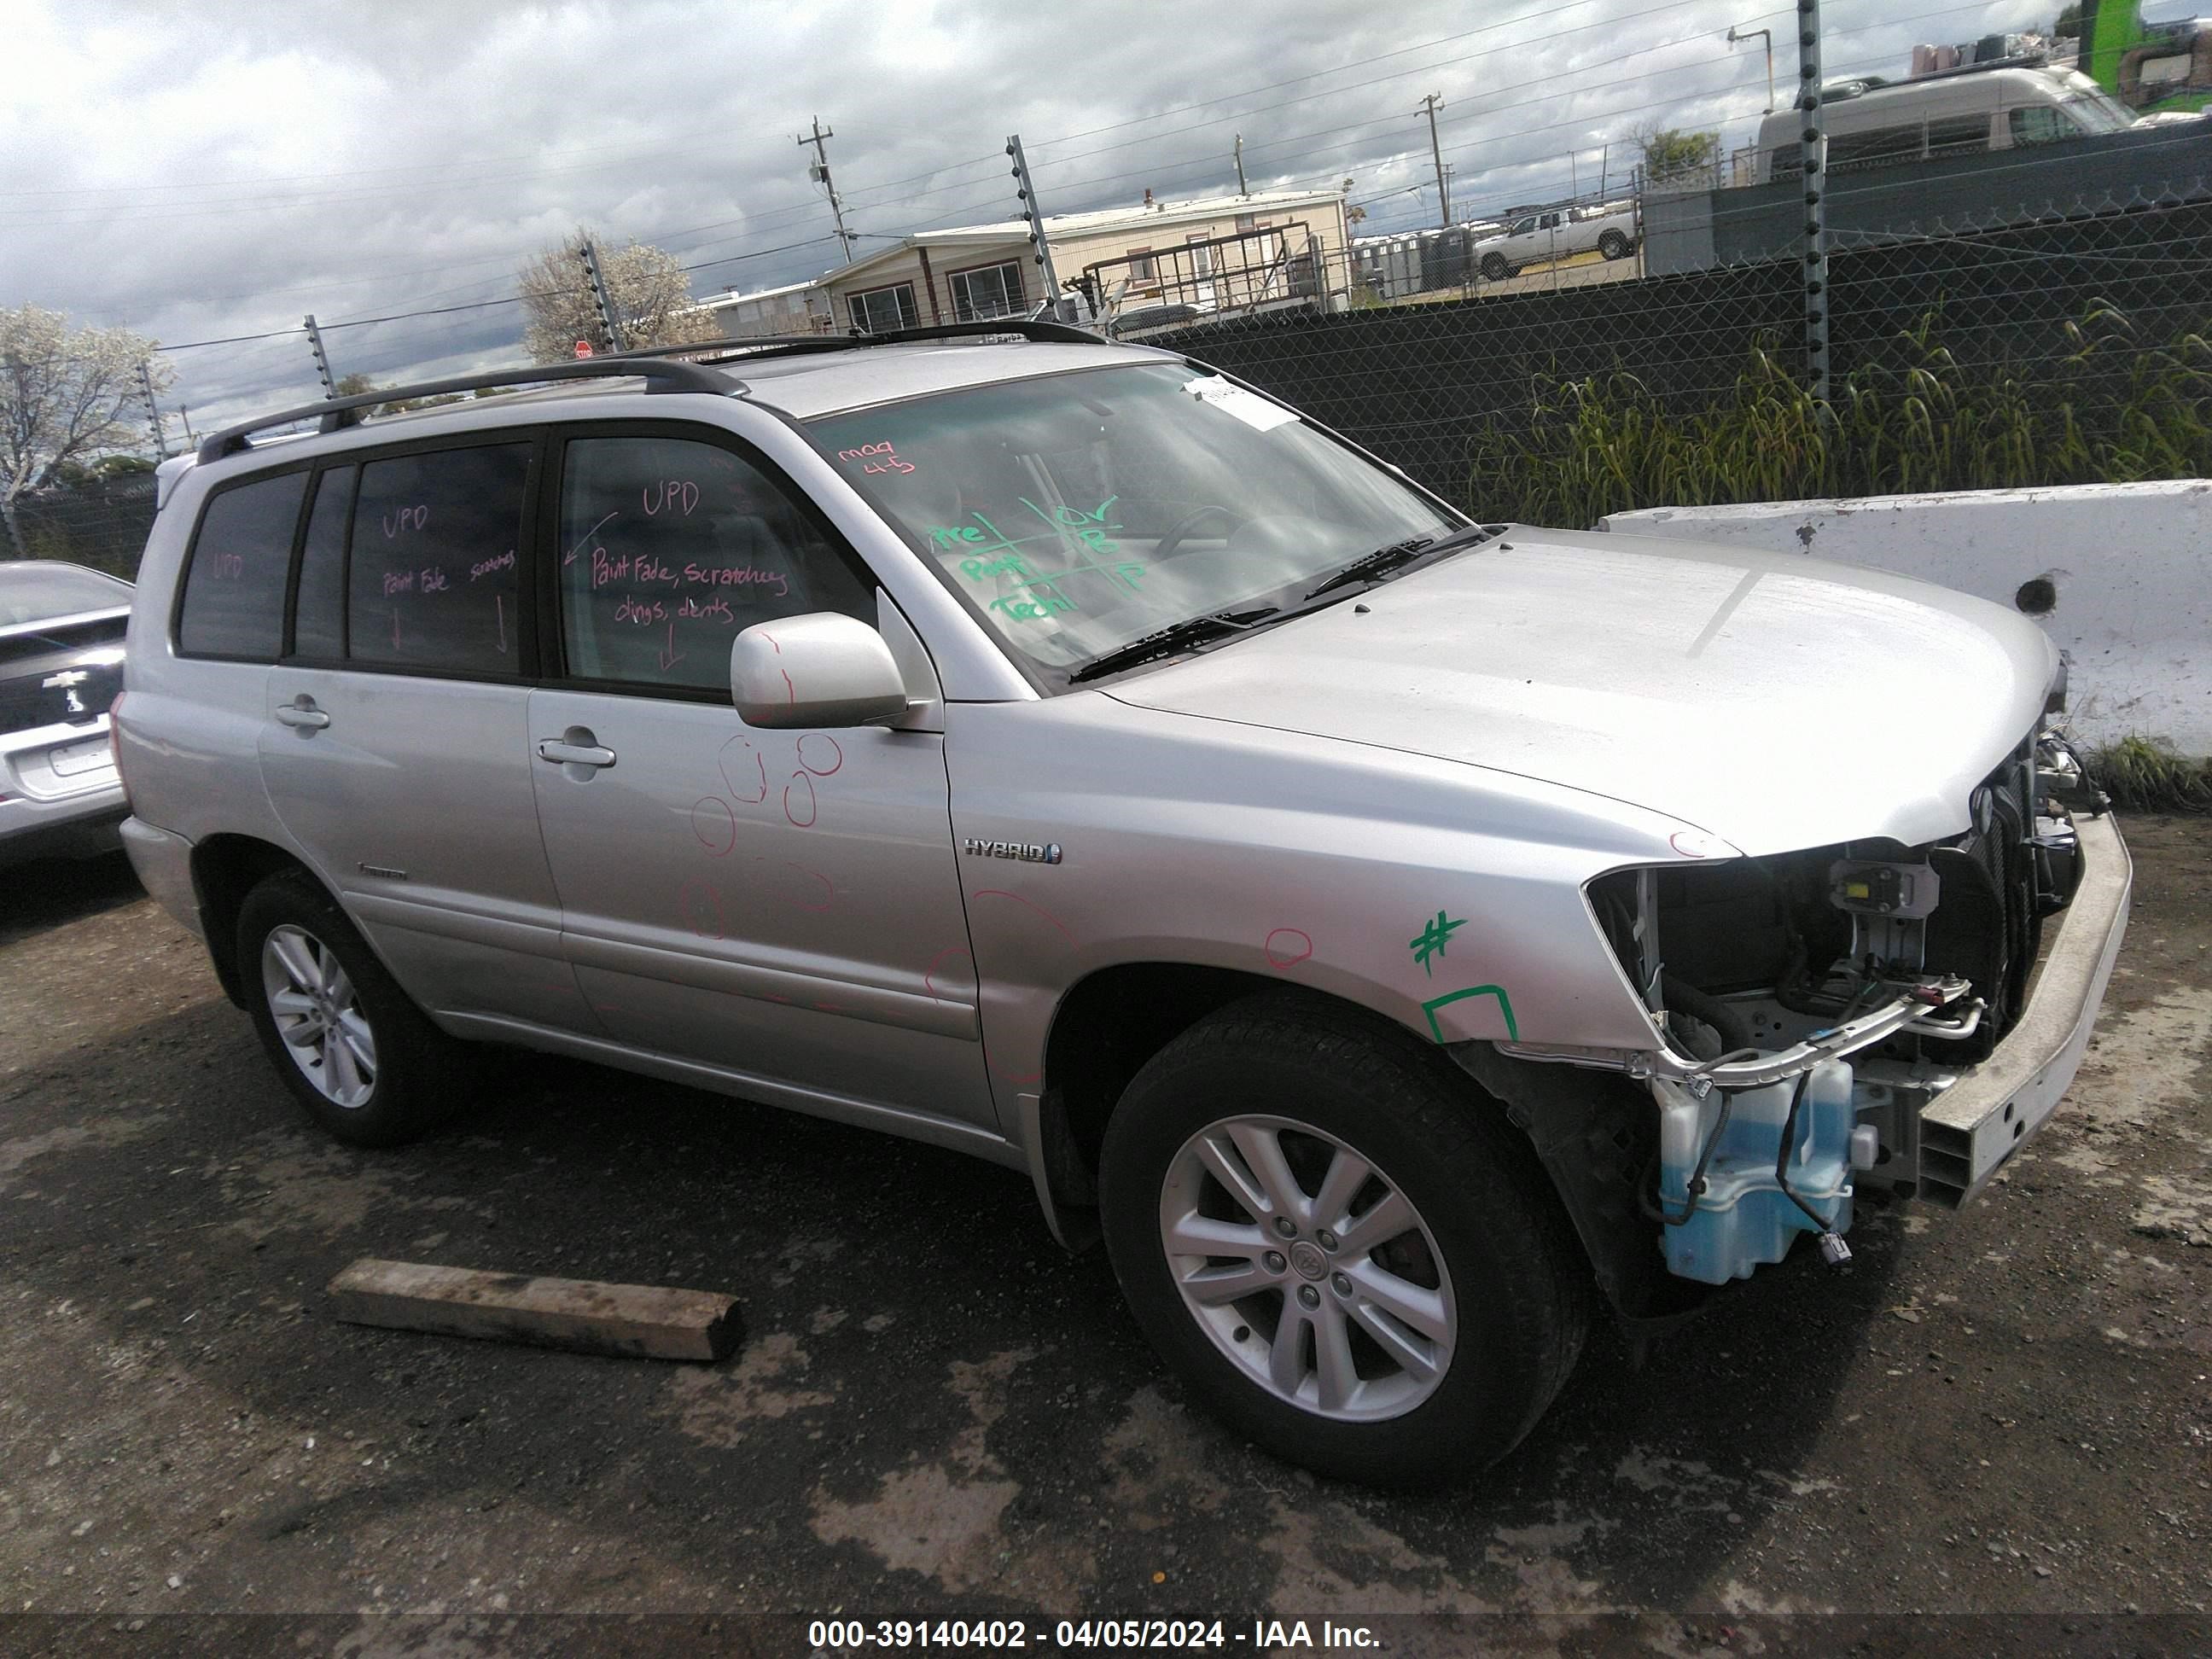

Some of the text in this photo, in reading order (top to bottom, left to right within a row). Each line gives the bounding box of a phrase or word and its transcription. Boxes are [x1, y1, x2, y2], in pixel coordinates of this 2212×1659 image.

[643, 480, 700, 515] UPD
[383, 505, 428, 538] UPD
[592, 547, 630, 590] Paint
[964, 838, 1045, 862] HYBRID
